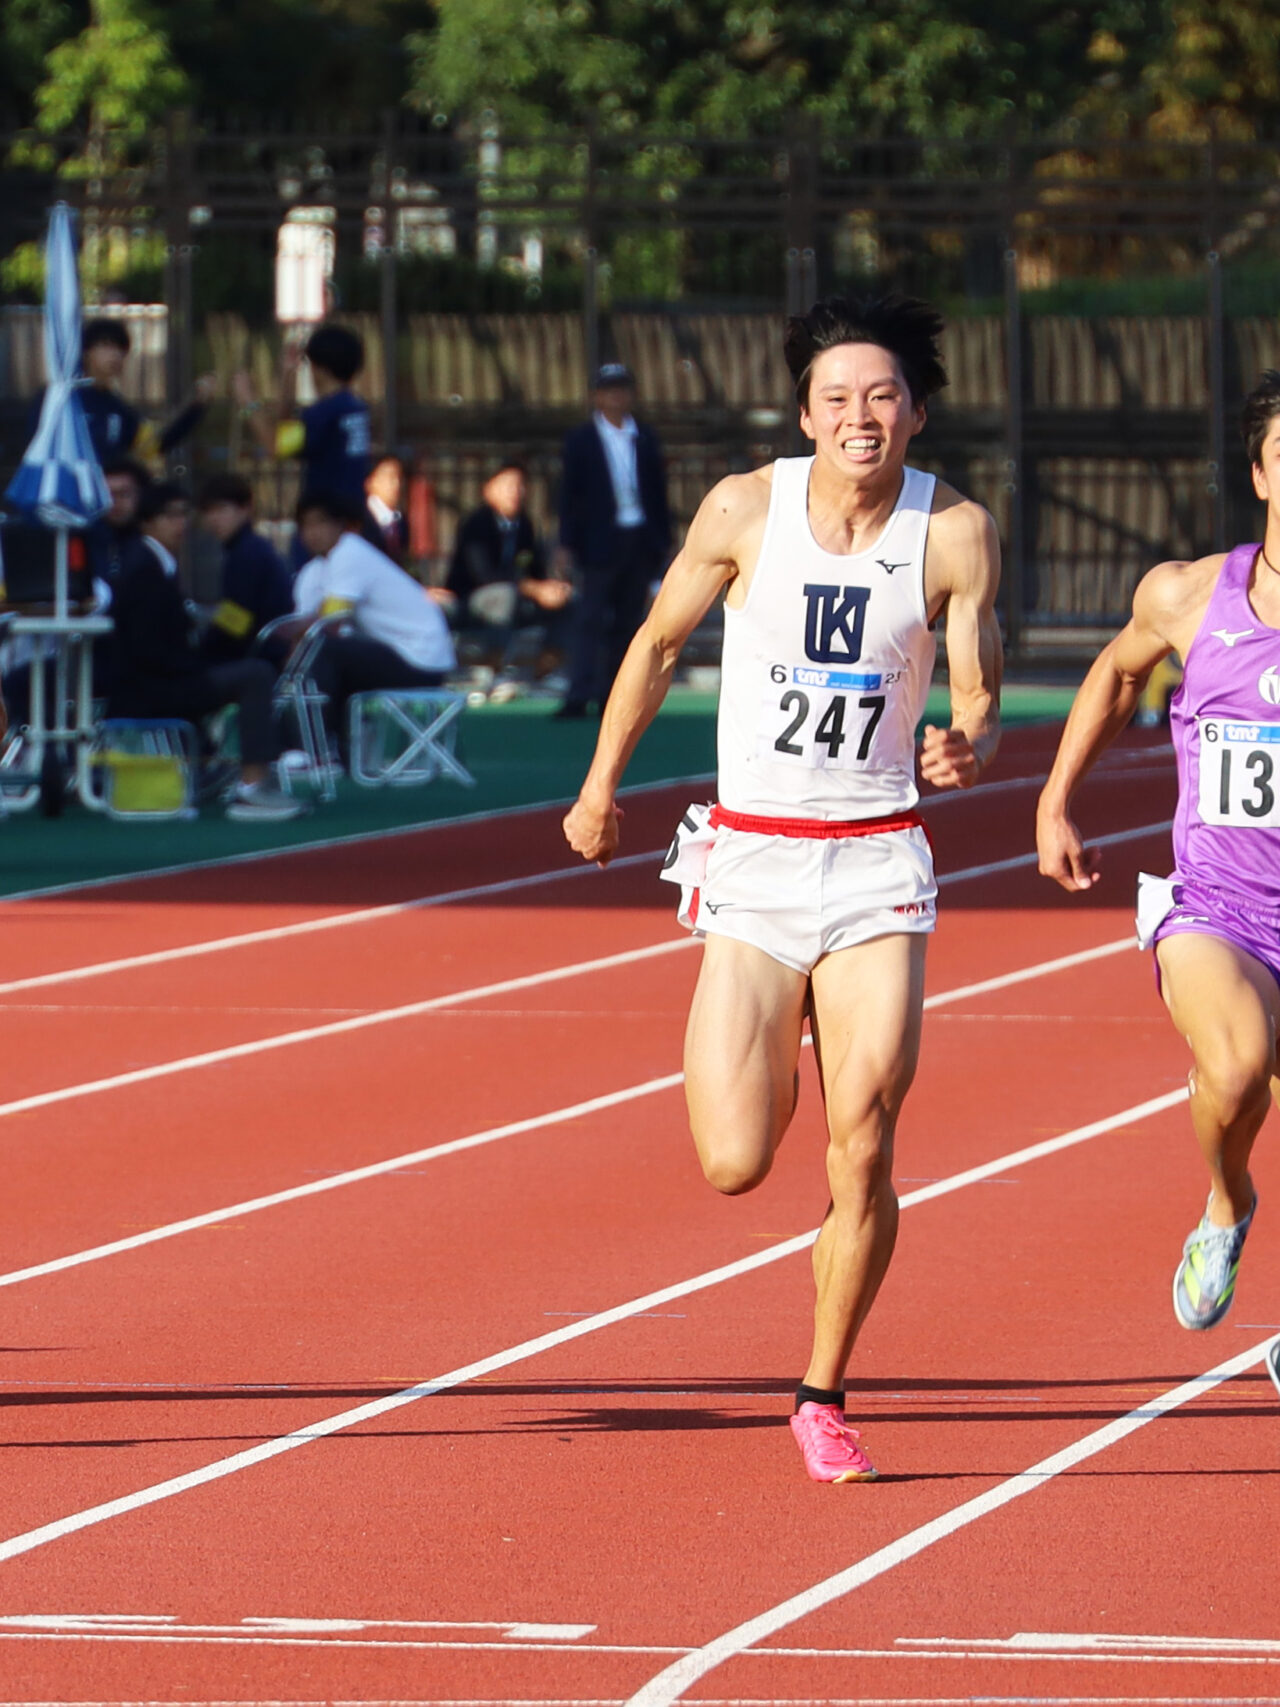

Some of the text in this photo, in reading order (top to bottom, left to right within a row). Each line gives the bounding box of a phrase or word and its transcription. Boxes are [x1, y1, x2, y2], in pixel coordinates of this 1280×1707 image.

[770, 664, 787, 683] 6
[774, 690, 886, 761] 247
[1204, 723, 1218, 743] 6
